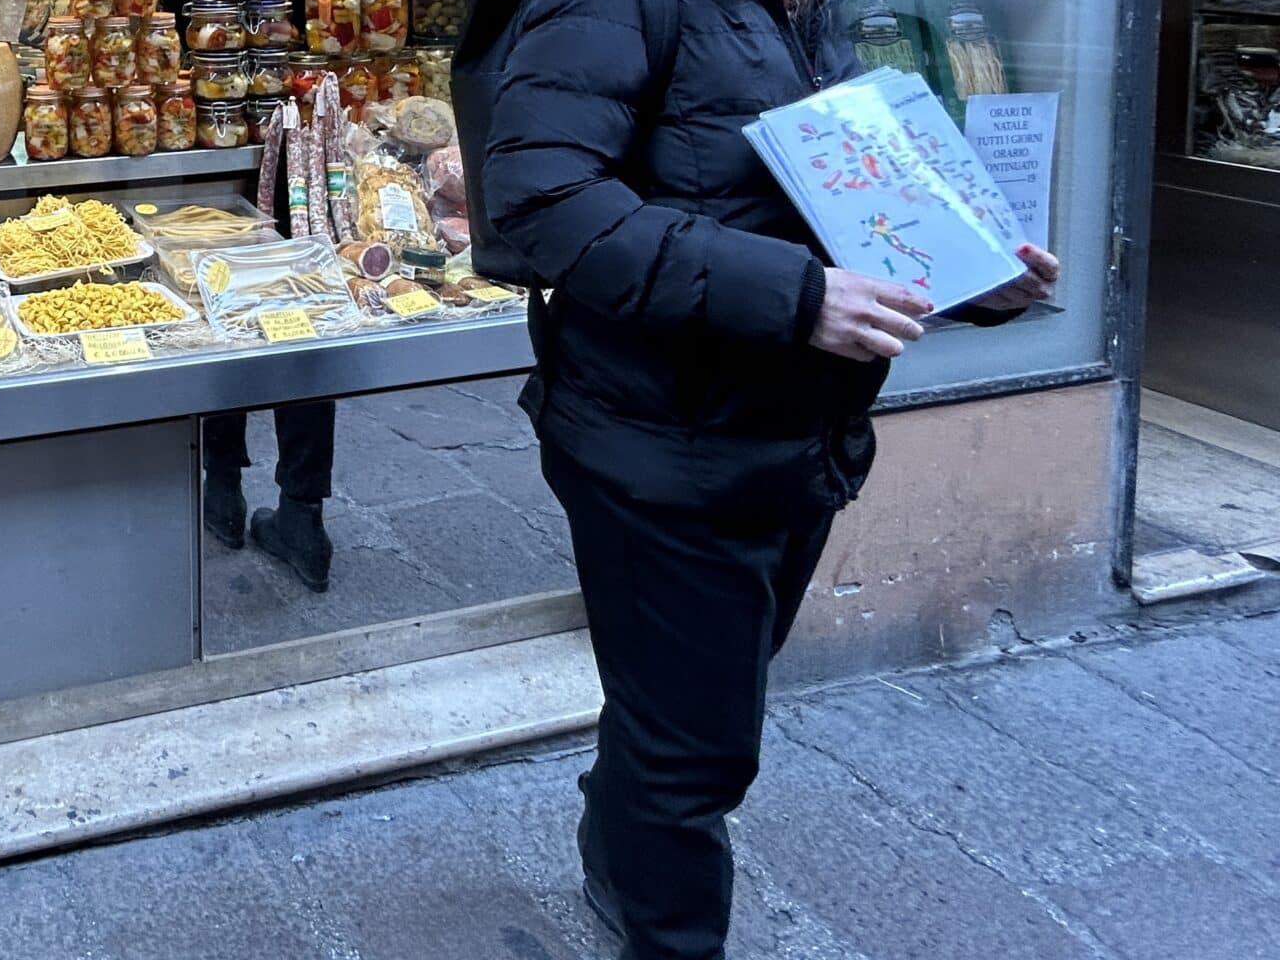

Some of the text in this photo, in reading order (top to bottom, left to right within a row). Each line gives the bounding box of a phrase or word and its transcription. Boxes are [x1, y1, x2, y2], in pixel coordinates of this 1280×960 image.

[990, 106, 1032, 118] ORARI DI
[993, 120, 1029, 132] NATALE
[976, 136, 1006, 147] TUTTI
[1011, 133, 1043, 144] GIORNI
[993, 147, 1030, 159] ORARIO
[985, 160, 1039, 173] ONTINUATO
[1027, 199, 1037, 209] 24
